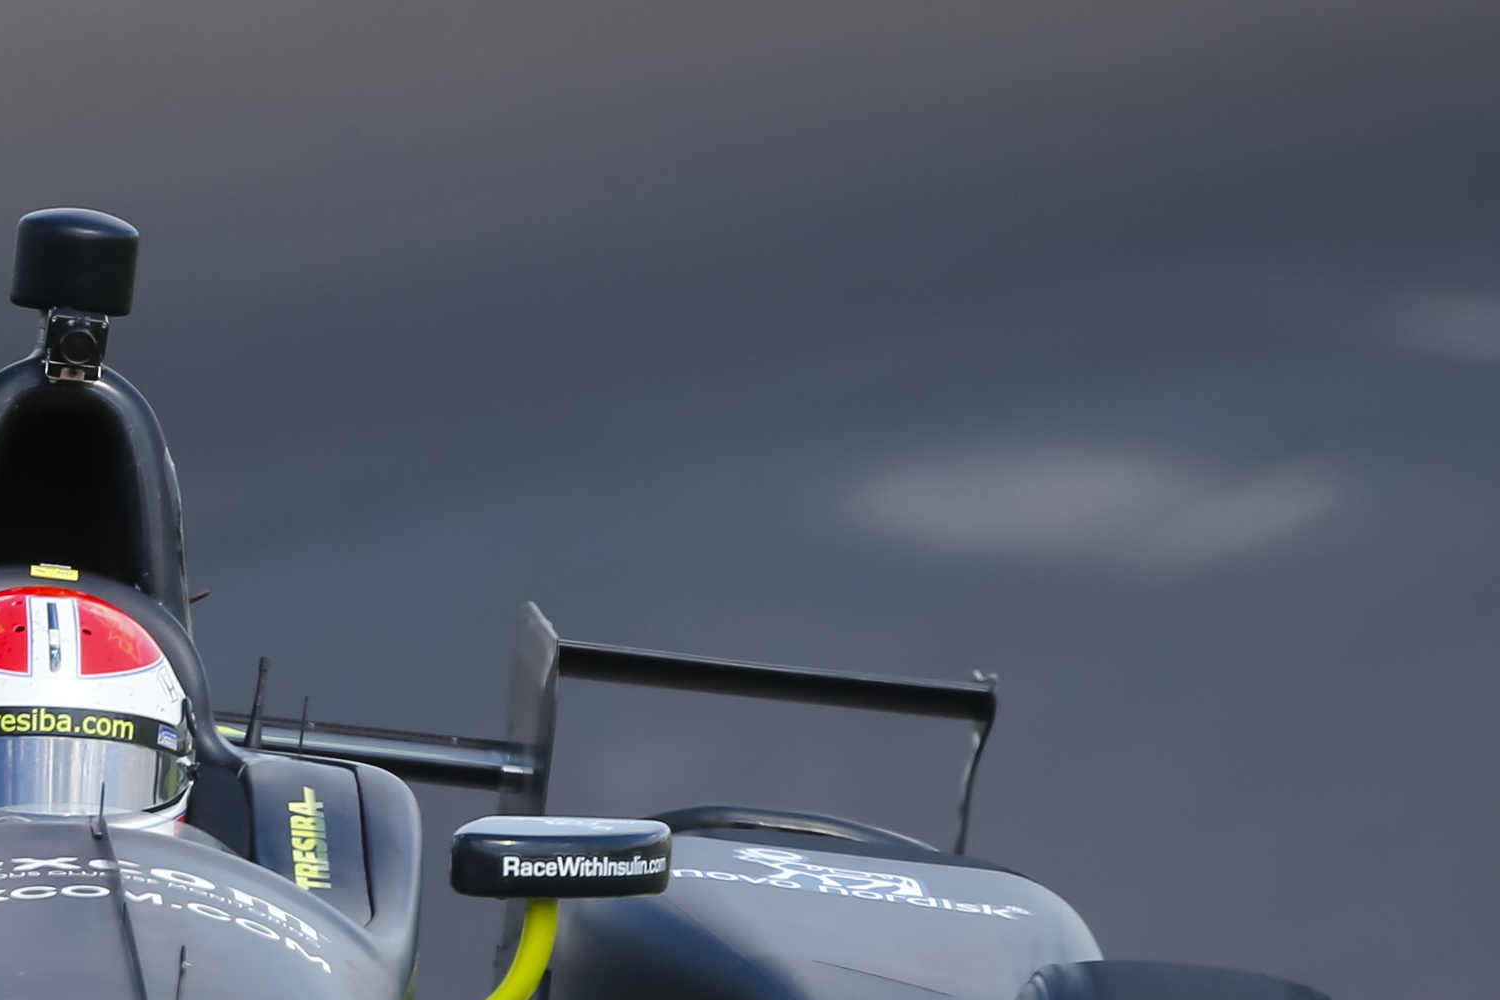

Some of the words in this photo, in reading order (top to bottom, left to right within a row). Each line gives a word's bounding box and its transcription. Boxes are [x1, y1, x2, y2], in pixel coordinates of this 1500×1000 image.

[288, 785, 332, 891] TRESIBA
[502, 855, 666, 878] RaceWithInsulin.com
[672, 868, 801, 889] novo
[818, 885, 1021, 921] nordisk
